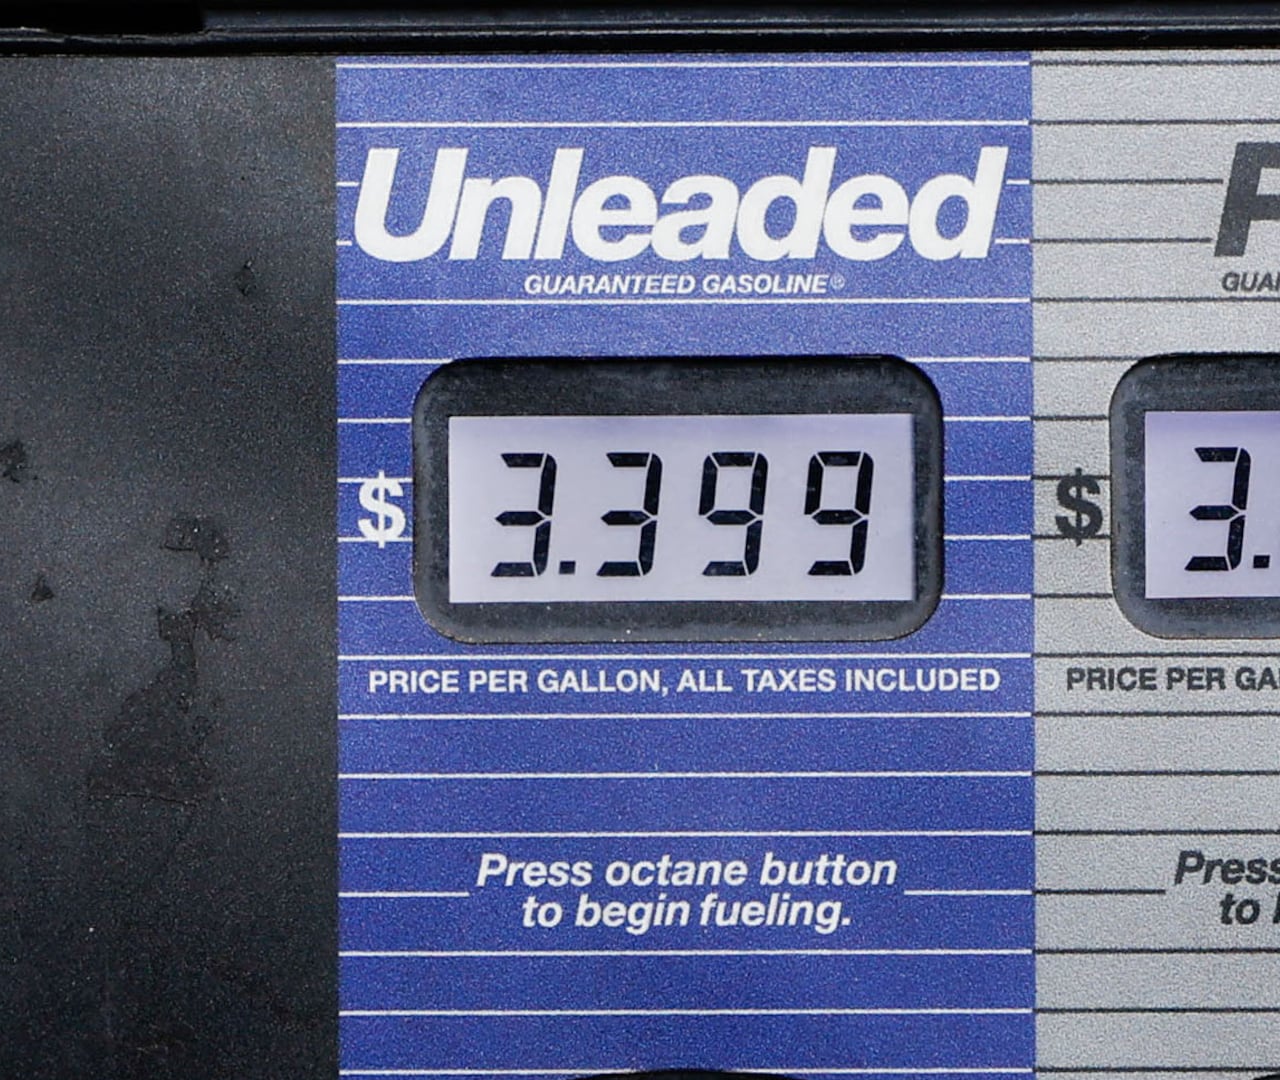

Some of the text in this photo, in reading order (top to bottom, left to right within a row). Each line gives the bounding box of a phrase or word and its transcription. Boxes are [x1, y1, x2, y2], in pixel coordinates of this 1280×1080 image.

[354, 147, 1009, 263] Unleaded
[524, 273, 696, 295] GUARANTEED
[357, 471, 406, 547] $
[490, 450, 874, 578] 3.399
[1054, 468, 1103, 544] $
[368, 668, 1001, 697] PRICE PER GALLON, ALL TAXES INCLUDED
[1066, 667, 1156, 692] PRICE
[1166, 667, 1226, 691] PER
[476, 853, 897, 888] Press octane button
[521, 896, 852, 935] to begin fueling.
[1220, 897, 1260, 926] to
